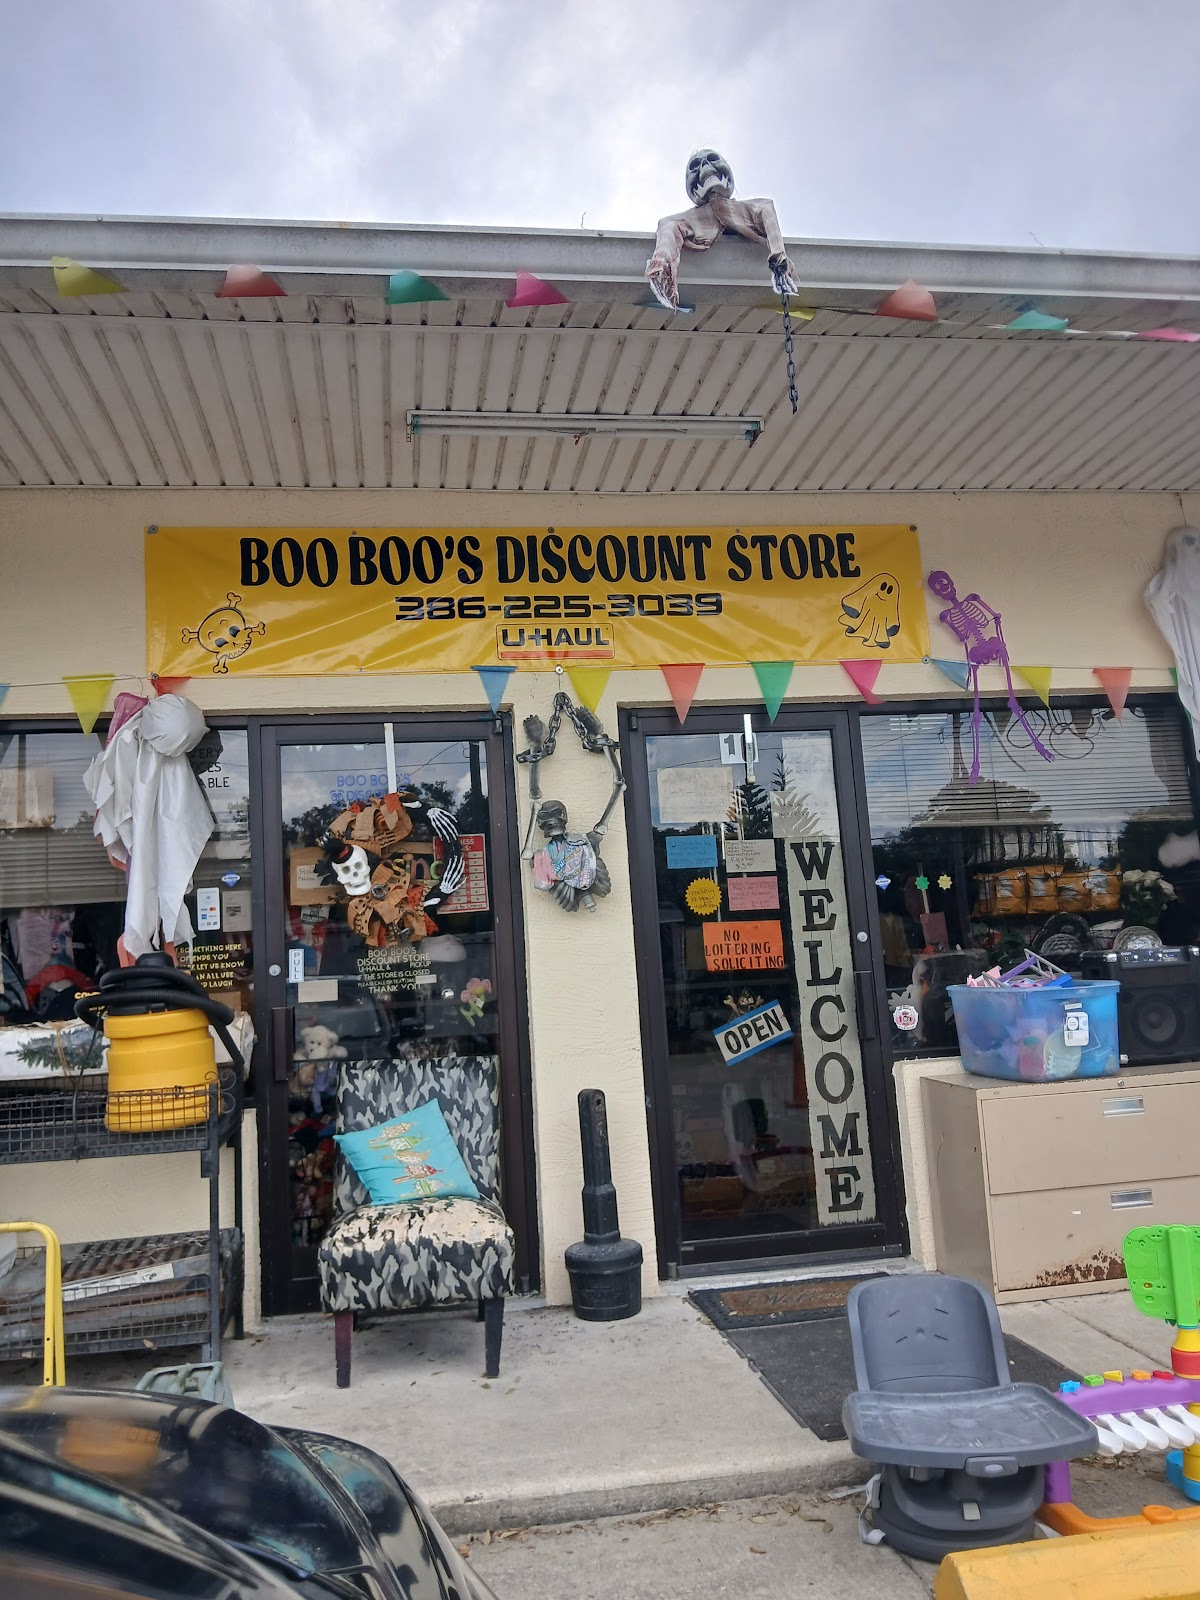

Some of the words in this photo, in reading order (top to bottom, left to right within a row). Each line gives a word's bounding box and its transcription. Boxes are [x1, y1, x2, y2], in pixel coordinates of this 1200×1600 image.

[240, 537, 339, 588] BOO
[348, 535, 484, 586] BOO'S
[496, 534, 711, 584] DISCOUNT
[727, 532, 861, 580] STORE
[395, 592, 723, 621] 386-225-3039
[502, 627, 610, 647] U-HAUL
[336, 774, 367, 788] BOO
[723, 929, 740, 942] NO
[225, 943, 242, 951] HERE
[368, 949, 388, 958] BOO
[390, 946, 417, 956] BOO'S
[705, 941, 771, 956] LOITERING
[179, 955, 211, 963] OFENDS
[220, 960, 245, 969] KNOW
[293, 951, 301, 980] PULL
[357, 955, 401, 966] DISCOUNT
[403, 953, 431, 963] STORE
[713, 955, 784, 970] SOLICITING
[377, 971, 397, 979] STORE
[368, 985, 398, 994] THANK
[723, 1008, 784, 1054] OPEN
[789, 841, 864, 1213] WELCOME
